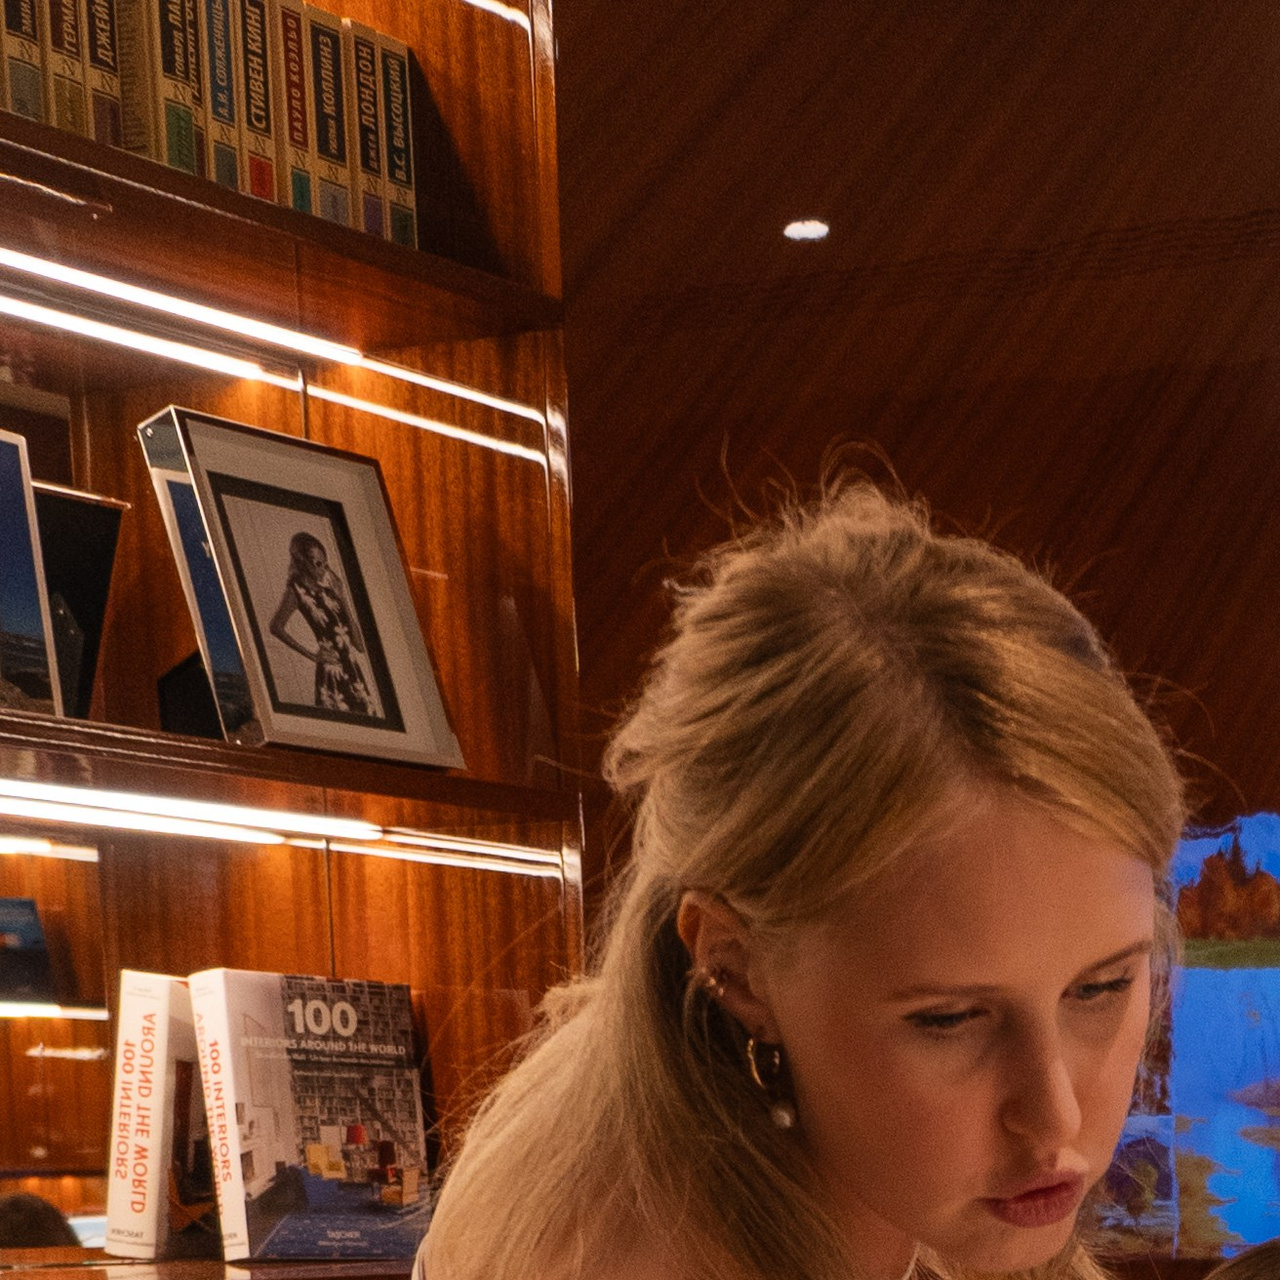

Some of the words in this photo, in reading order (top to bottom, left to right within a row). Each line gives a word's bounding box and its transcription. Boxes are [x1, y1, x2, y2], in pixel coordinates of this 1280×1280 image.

[209, 0, 228, 87] СОЛЖЕНИЦЫ
[246, 0, 262, 54] КИНГ
[286, 17, 301, 80] КОЭЛЬО
[248, 54, 268, 130] СТИВЕН
[318, 34, 338, 118] КОЛЛИНЗ
[358, 44, 377, 131] ЛОНДОН
[386, 57, 406, 149] ВЫСОЦКИЙ
[290, 88, 305, 143] ПАУЛО
[287, 998, 358, 1037] 100
[300, 1038, 347, 1051] AROUND
[348, 1041, 367, 1053] THE
[368, 1042, 406, 1055] WORLD
[208, 1039, 222, 1076] 100
[213, 1081, 233, 1184] INTERIORS
